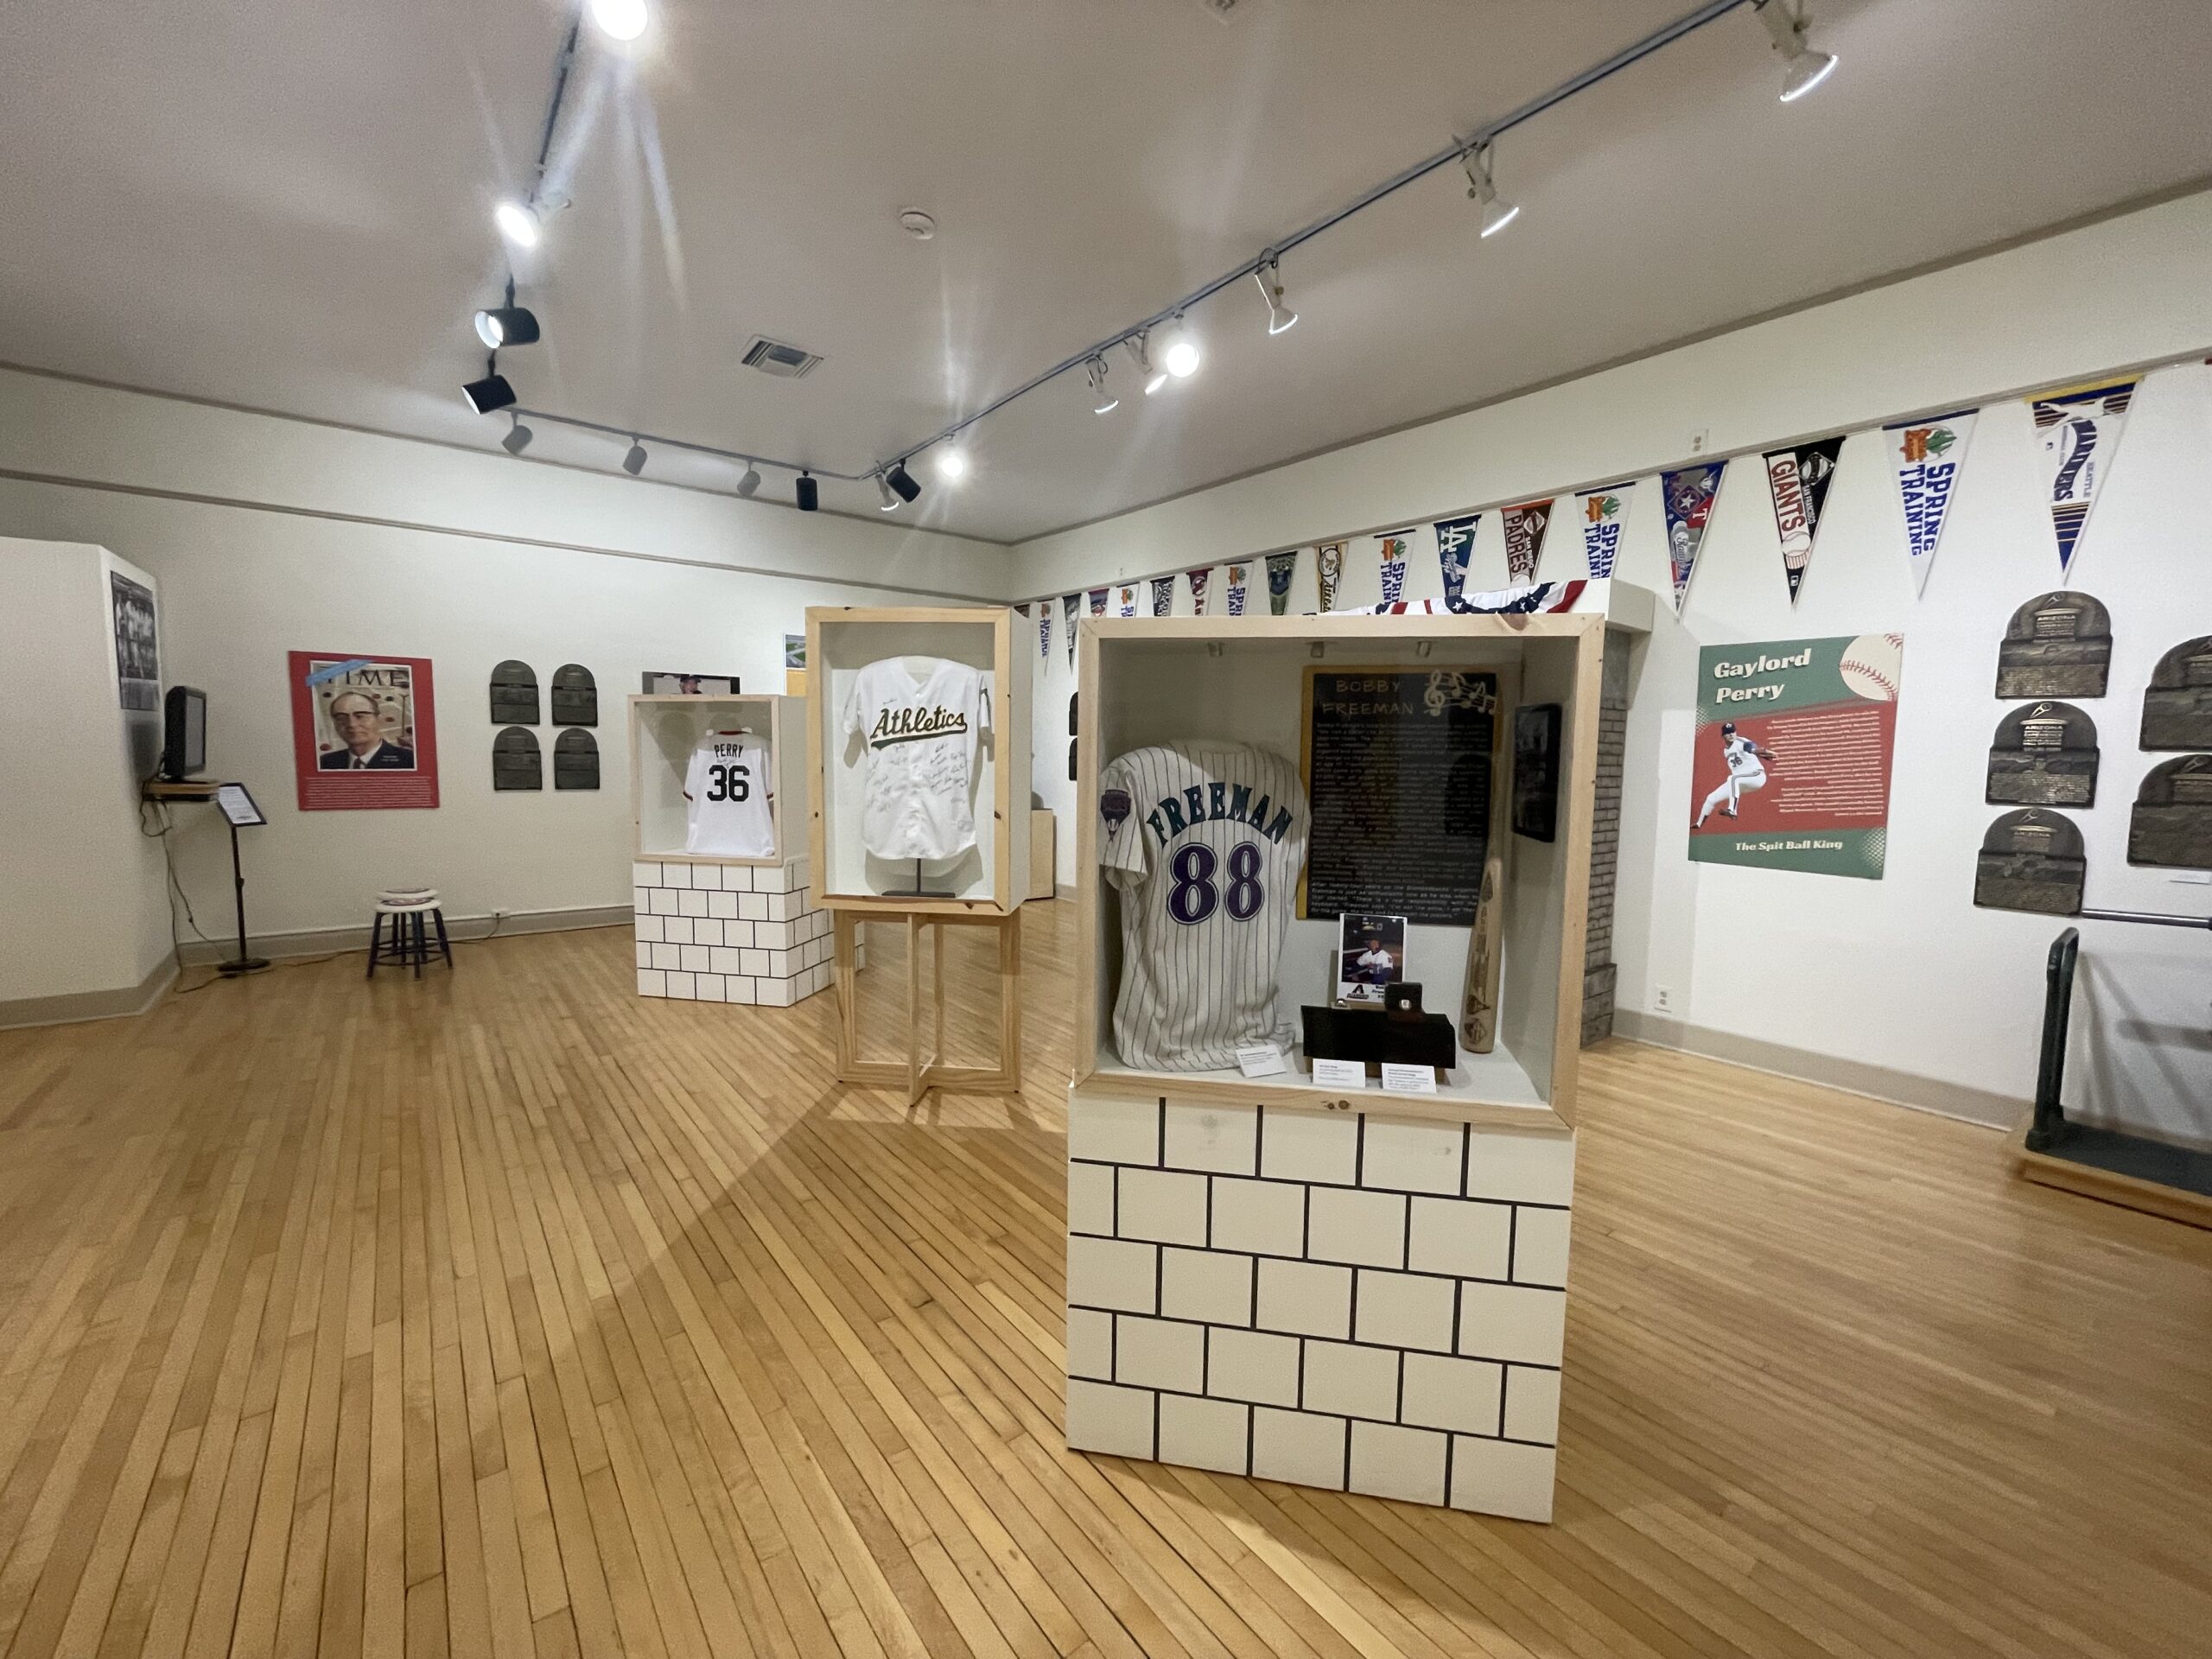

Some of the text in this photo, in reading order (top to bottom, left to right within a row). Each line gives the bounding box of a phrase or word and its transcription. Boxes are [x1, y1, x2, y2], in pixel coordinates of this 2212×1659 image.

[1771, 461, 1806, 532] GIANTS
[1899, 464, 1925, 556] TRAINING
[1923, 462, 1956, 551] SPRING
[1505, 515, 1528, 574] PADRES
[1584, 524, 1601, 579] TRAINI
[1600, 523, 1620, 578] SPRIN
[1392, 562, 1406, 603] SPRI
[324, 669, 410, 687] IME
[1714, 648, 1811, 678] Gaylord
[1336, 680, 1402, 692] BOBBY
[1716, 684, 1785, 703] Perry
[869, 704, 966, 741] Athletics
[1322, 702, 1414, 715] FREEMAN
[714, 743, 745, 758] PERRY
[707, 765, 750, 802] 36
[1146, 782, 1294, 849] FREEMAN
[1735, 840, 1843, 852] The Spit Ball King
[1167, 841, 1265, 925] 88
